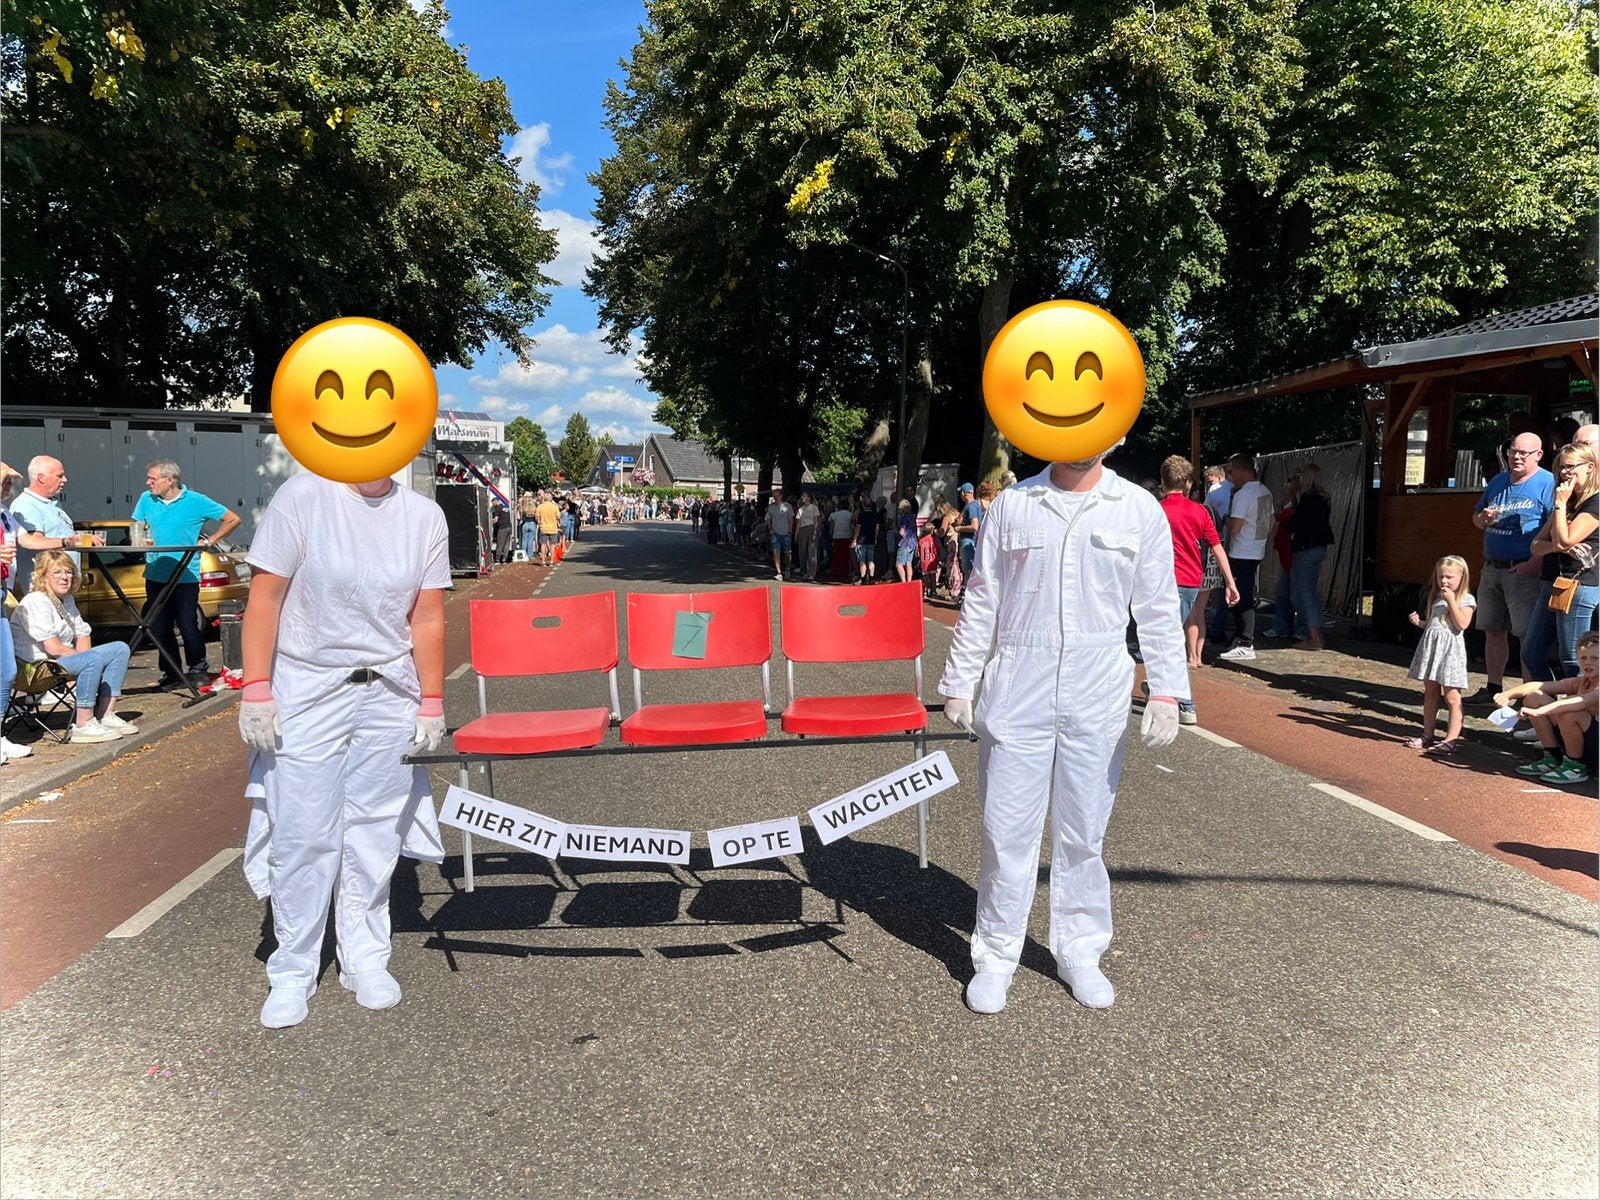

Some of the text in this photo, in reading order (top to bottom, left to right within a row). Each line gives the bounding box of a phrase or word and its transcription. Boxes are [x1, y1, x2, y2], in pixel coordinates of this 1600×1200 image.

[681, 623, 703, 651] 7
[823, 763, 944, 829] WACHTEN
[455, 802, 558, 850] HIER ZIT
[566, 832, 684, 857] NIEMAND
[722, 830, 792, 858] OP TE
